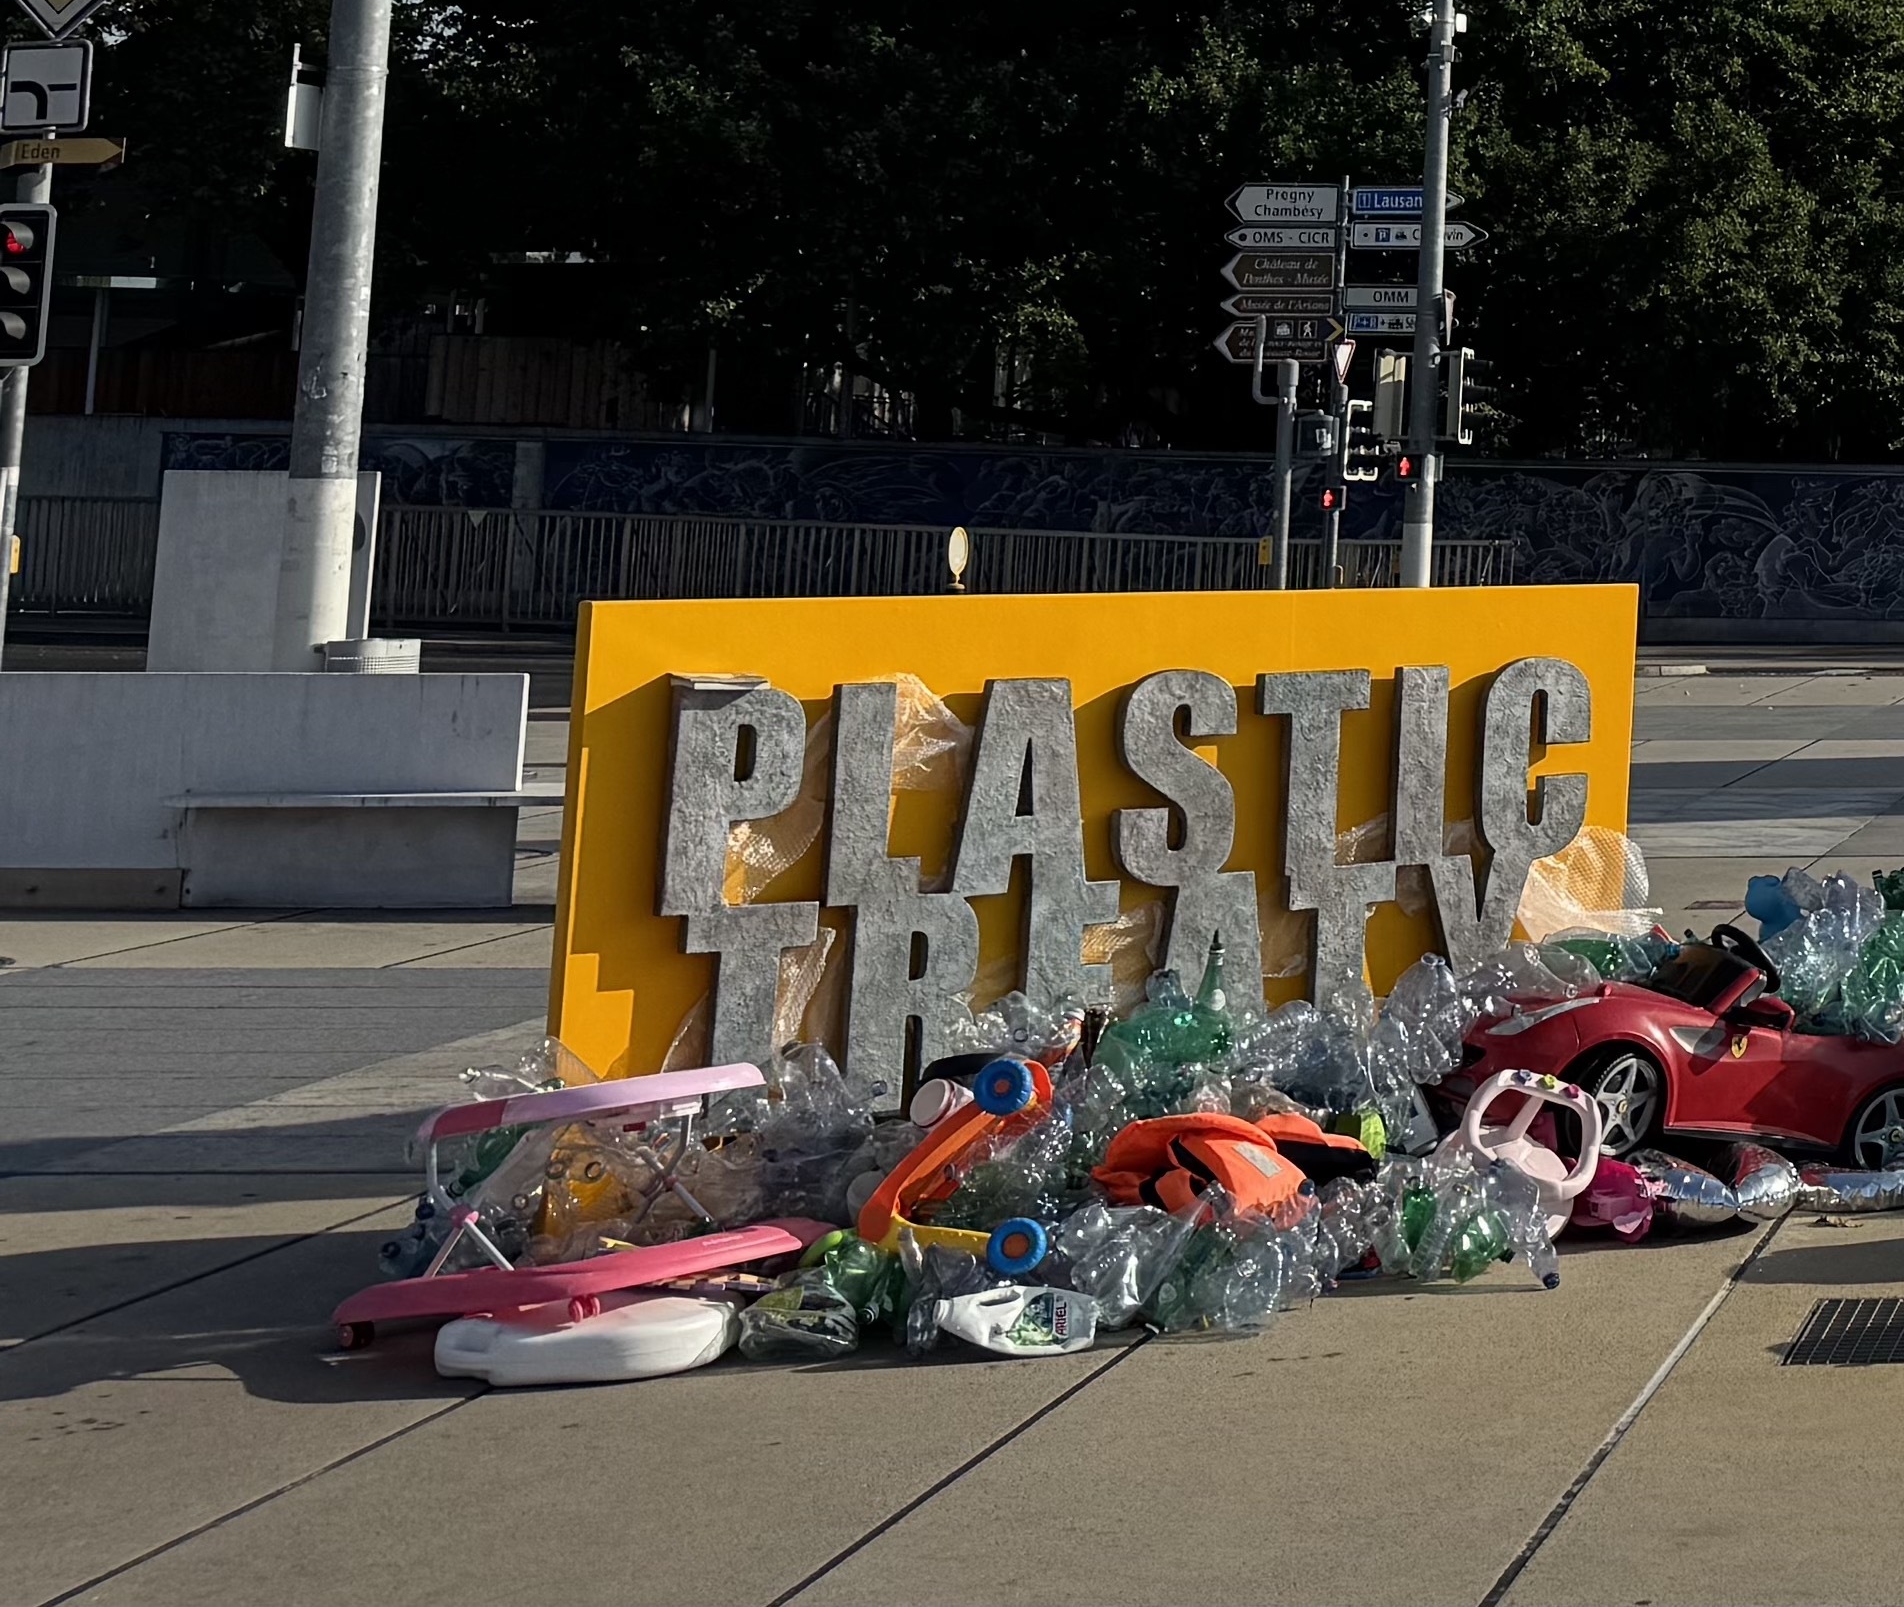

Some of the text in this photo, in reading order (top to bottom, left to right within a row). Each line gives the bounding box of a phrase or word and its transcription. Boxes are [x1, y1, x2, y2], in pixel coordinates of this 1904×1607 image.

[21, 143, 60, 160] Eden
[1373, 193, 1423, 209] Lausan
[1254, 204, 1324, 220] Chambésy
[1252, 231, 1284, 244] OMS
[1298, 231, 1330, 244] CICR
[1304, 257, 1319, 270] de
[1373, 290, 1410, 303] OMM
[657, 656, 1592, 916] PLASTIC
